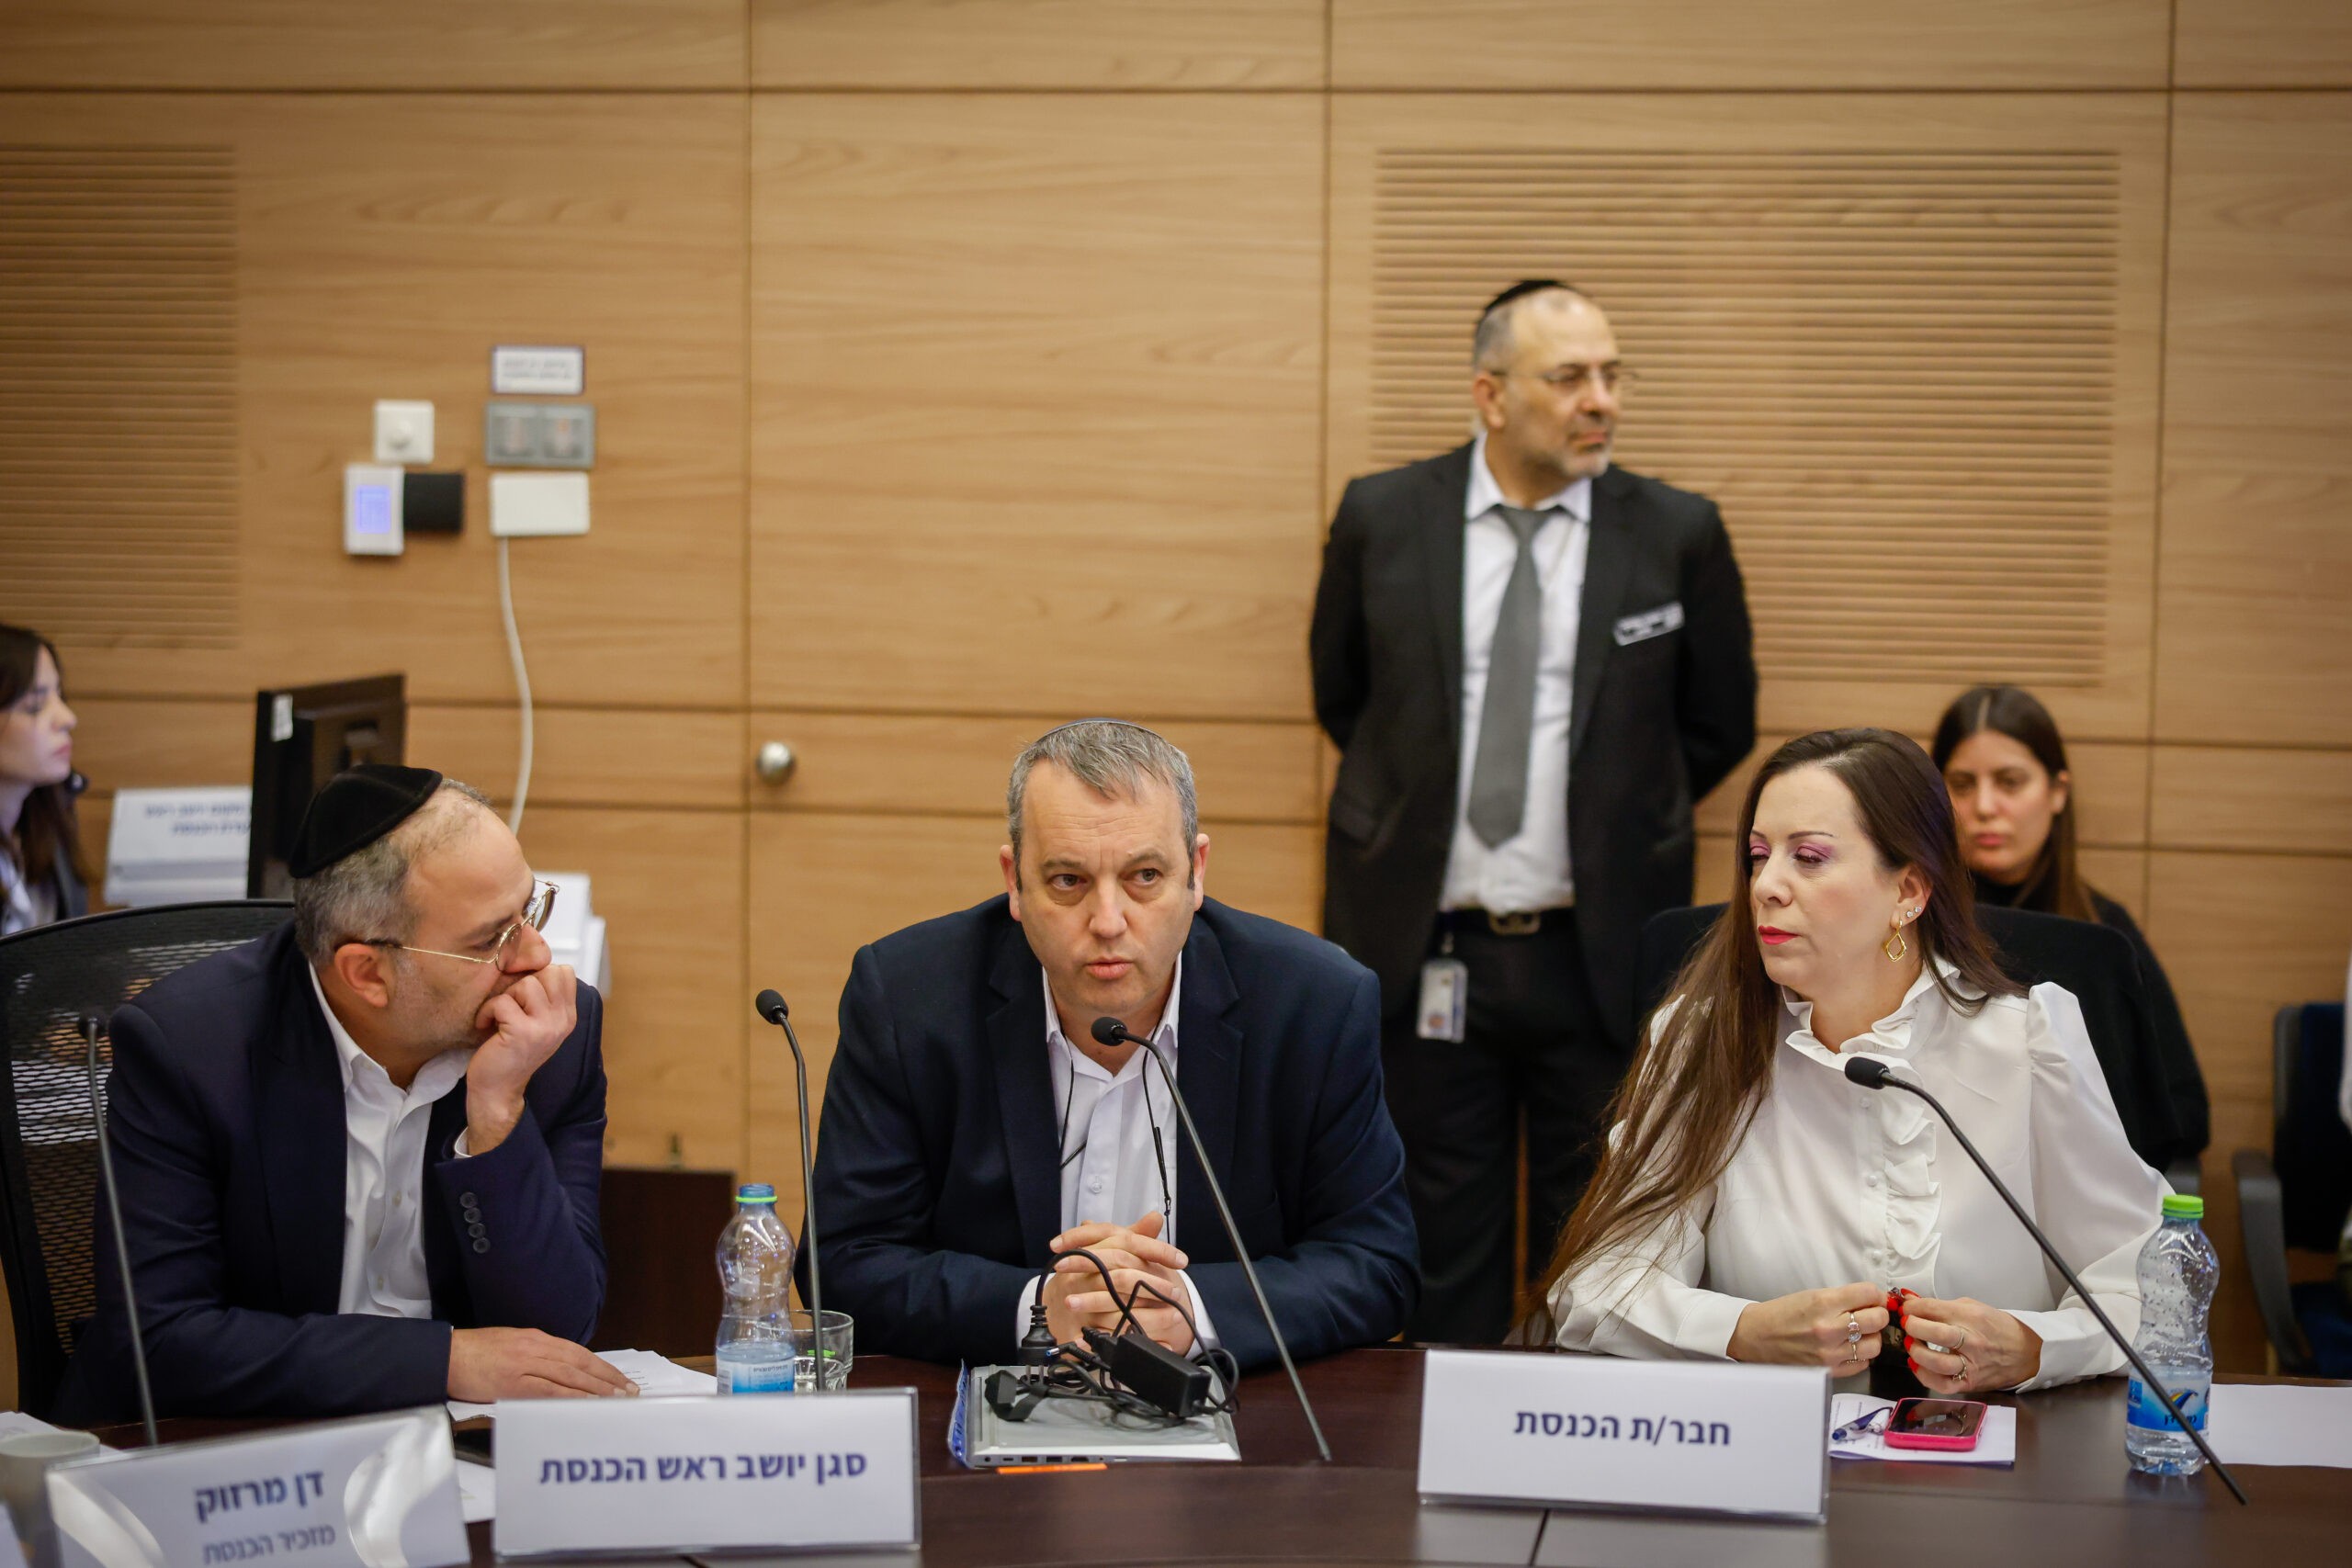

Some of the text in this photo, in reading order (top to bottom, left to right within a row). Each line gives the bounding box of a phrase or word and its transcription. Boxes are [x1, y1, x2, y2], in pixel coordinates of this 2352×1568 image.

[1514, 1411, 1731, 1446] חבר/ת הכנסת
[540, 1453, 867, 1485] סגן יושב ראש הכנסת
[195, 1471, 323, 1525] דן מרזוק
[203, 1524, 336, 1565] מזכיר הכנסת
